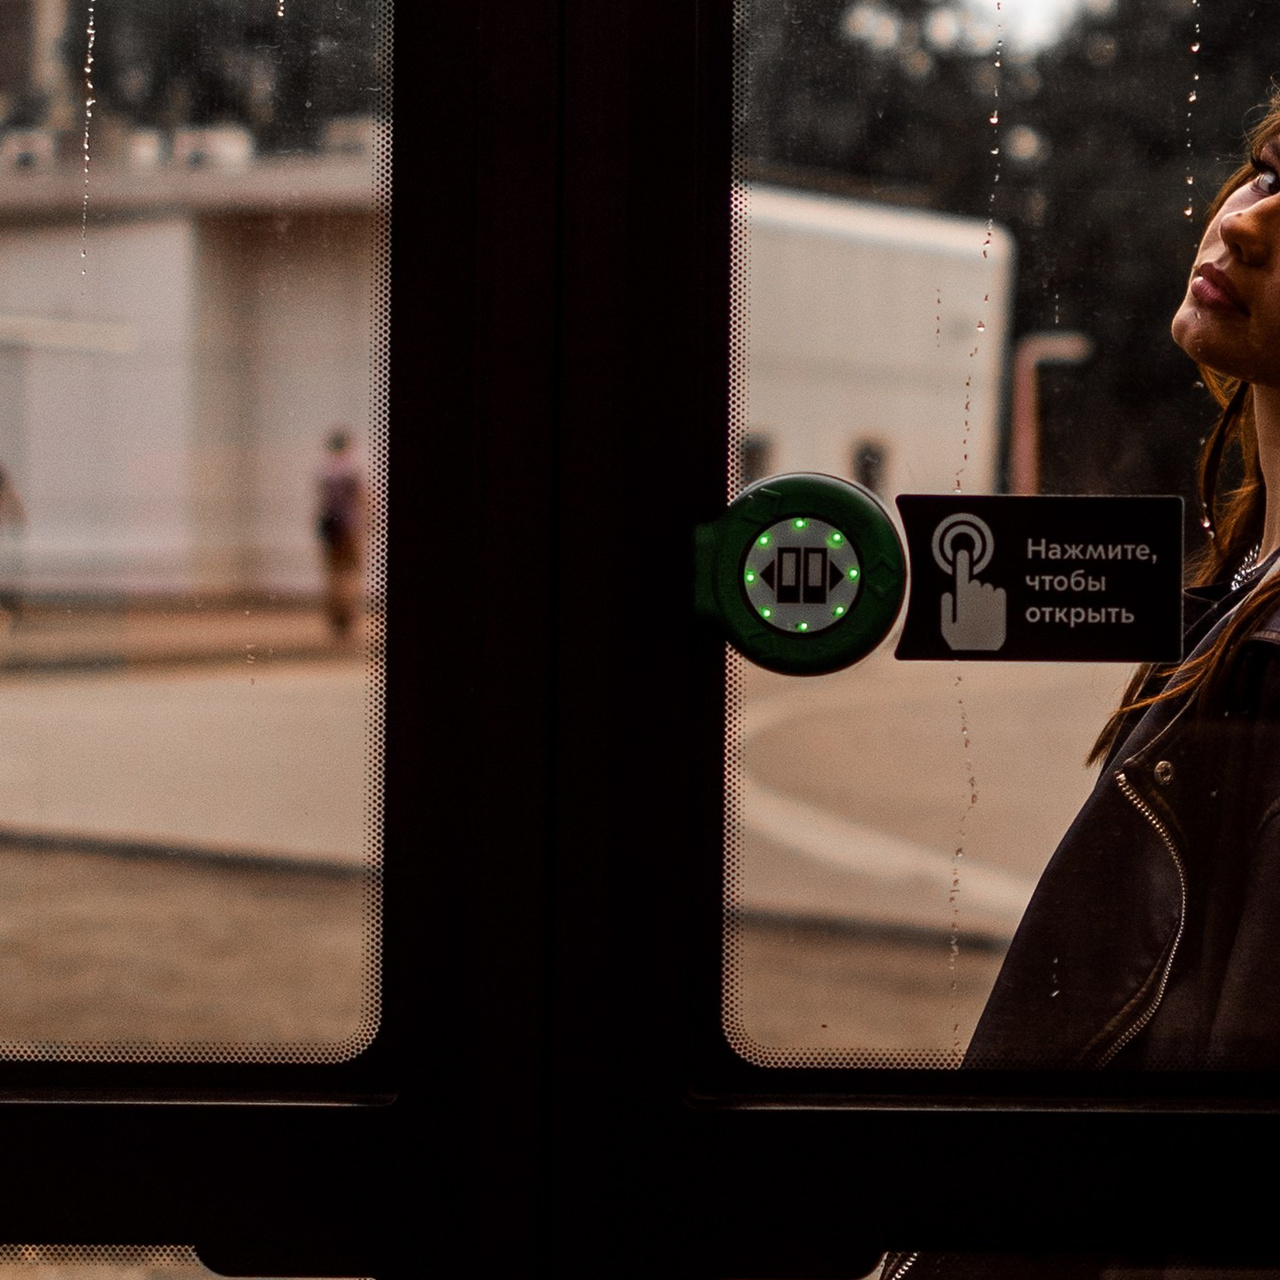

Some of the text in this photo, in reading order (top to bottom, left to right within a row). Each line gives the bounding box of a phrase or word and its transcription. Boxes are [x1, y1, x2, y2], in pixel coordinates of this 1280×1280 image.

[1026, 537, 1159, 565] Нажмите,
[1025, 569, 1106, 592] чтобы
[1025, 606, 1135, 628] открыть
